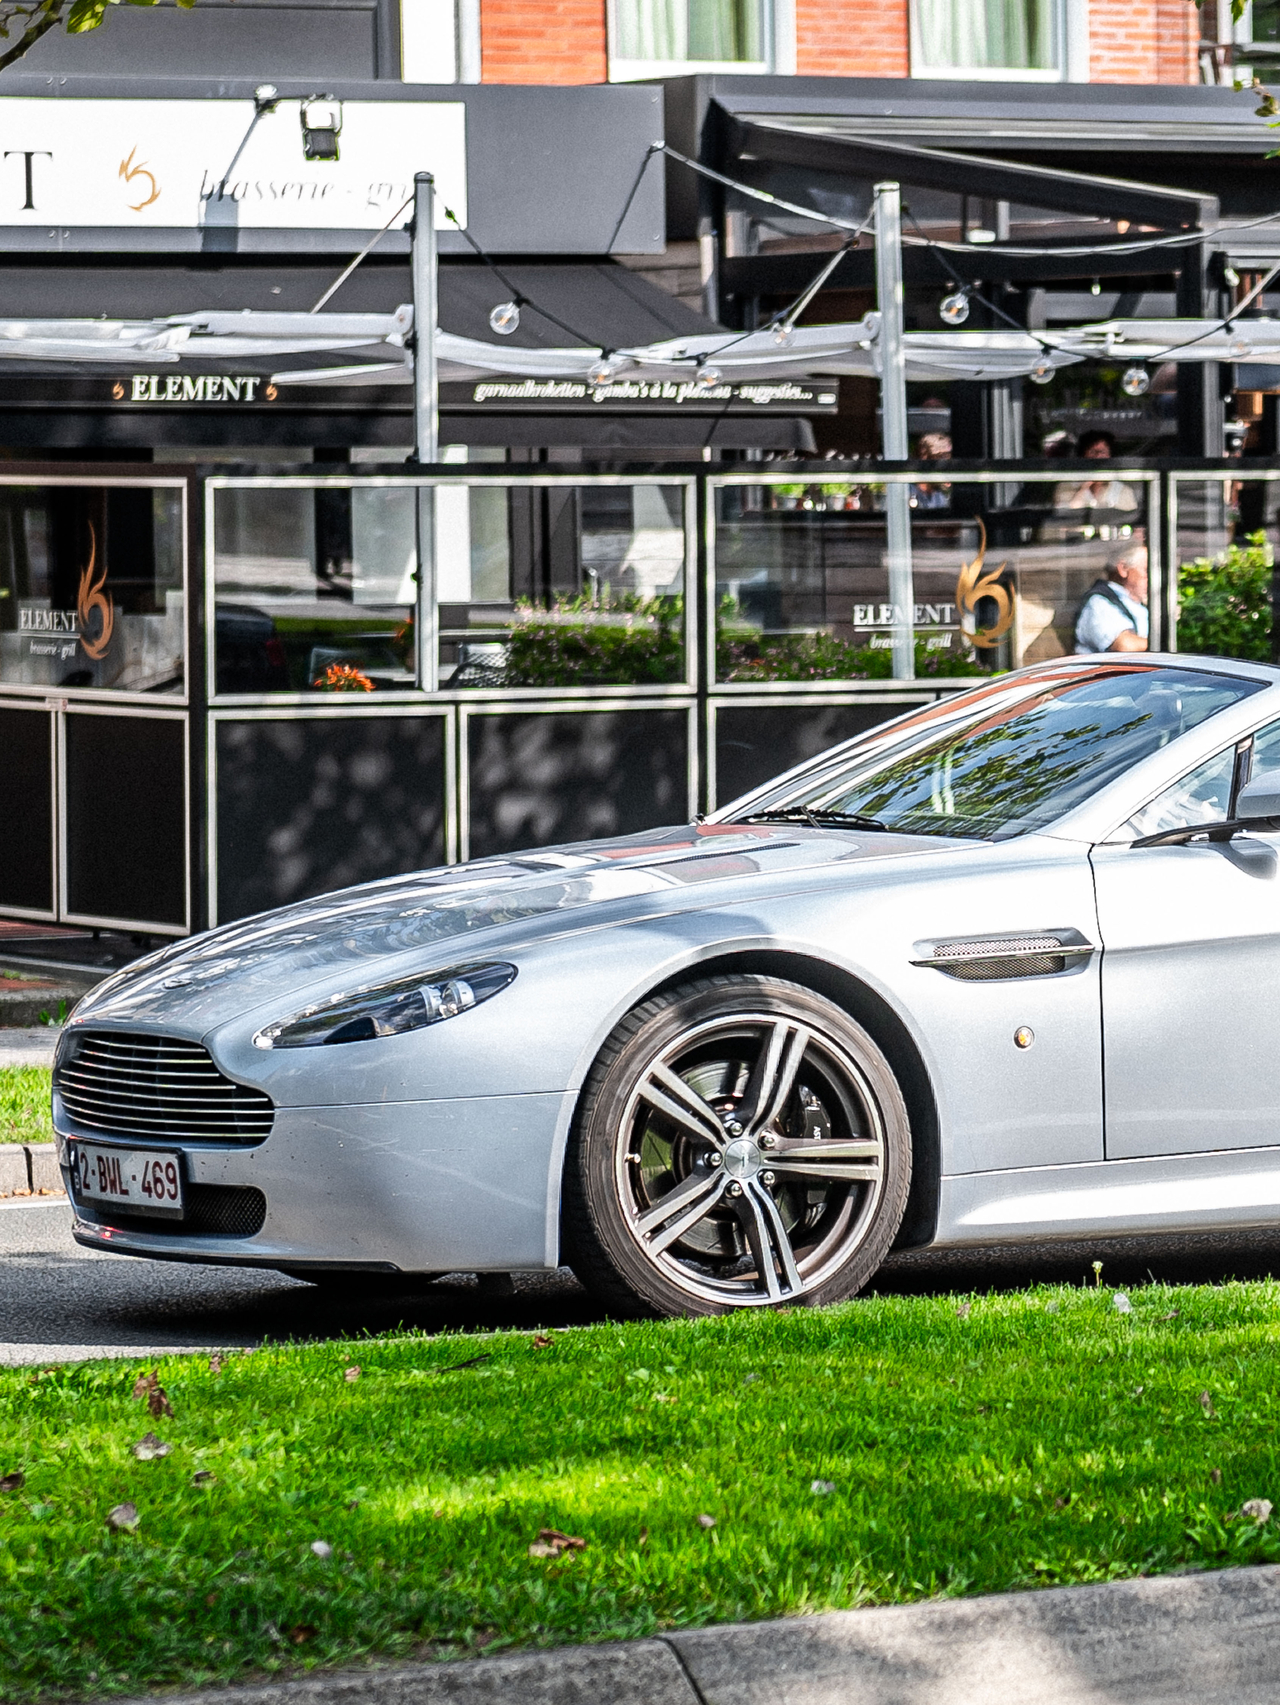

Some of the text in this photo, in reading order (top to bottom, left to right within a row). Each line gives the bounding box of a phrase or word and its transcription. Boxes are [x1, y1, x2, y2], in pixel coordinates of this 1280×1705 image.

[200, 169, 334, 202] brasserie
[131, 375, 260, 401] ELEMENT
[662, 380, 677, 398] la
[20, 608, 78, 632] ELEMENT
[926, 632, 953, 652] grill
